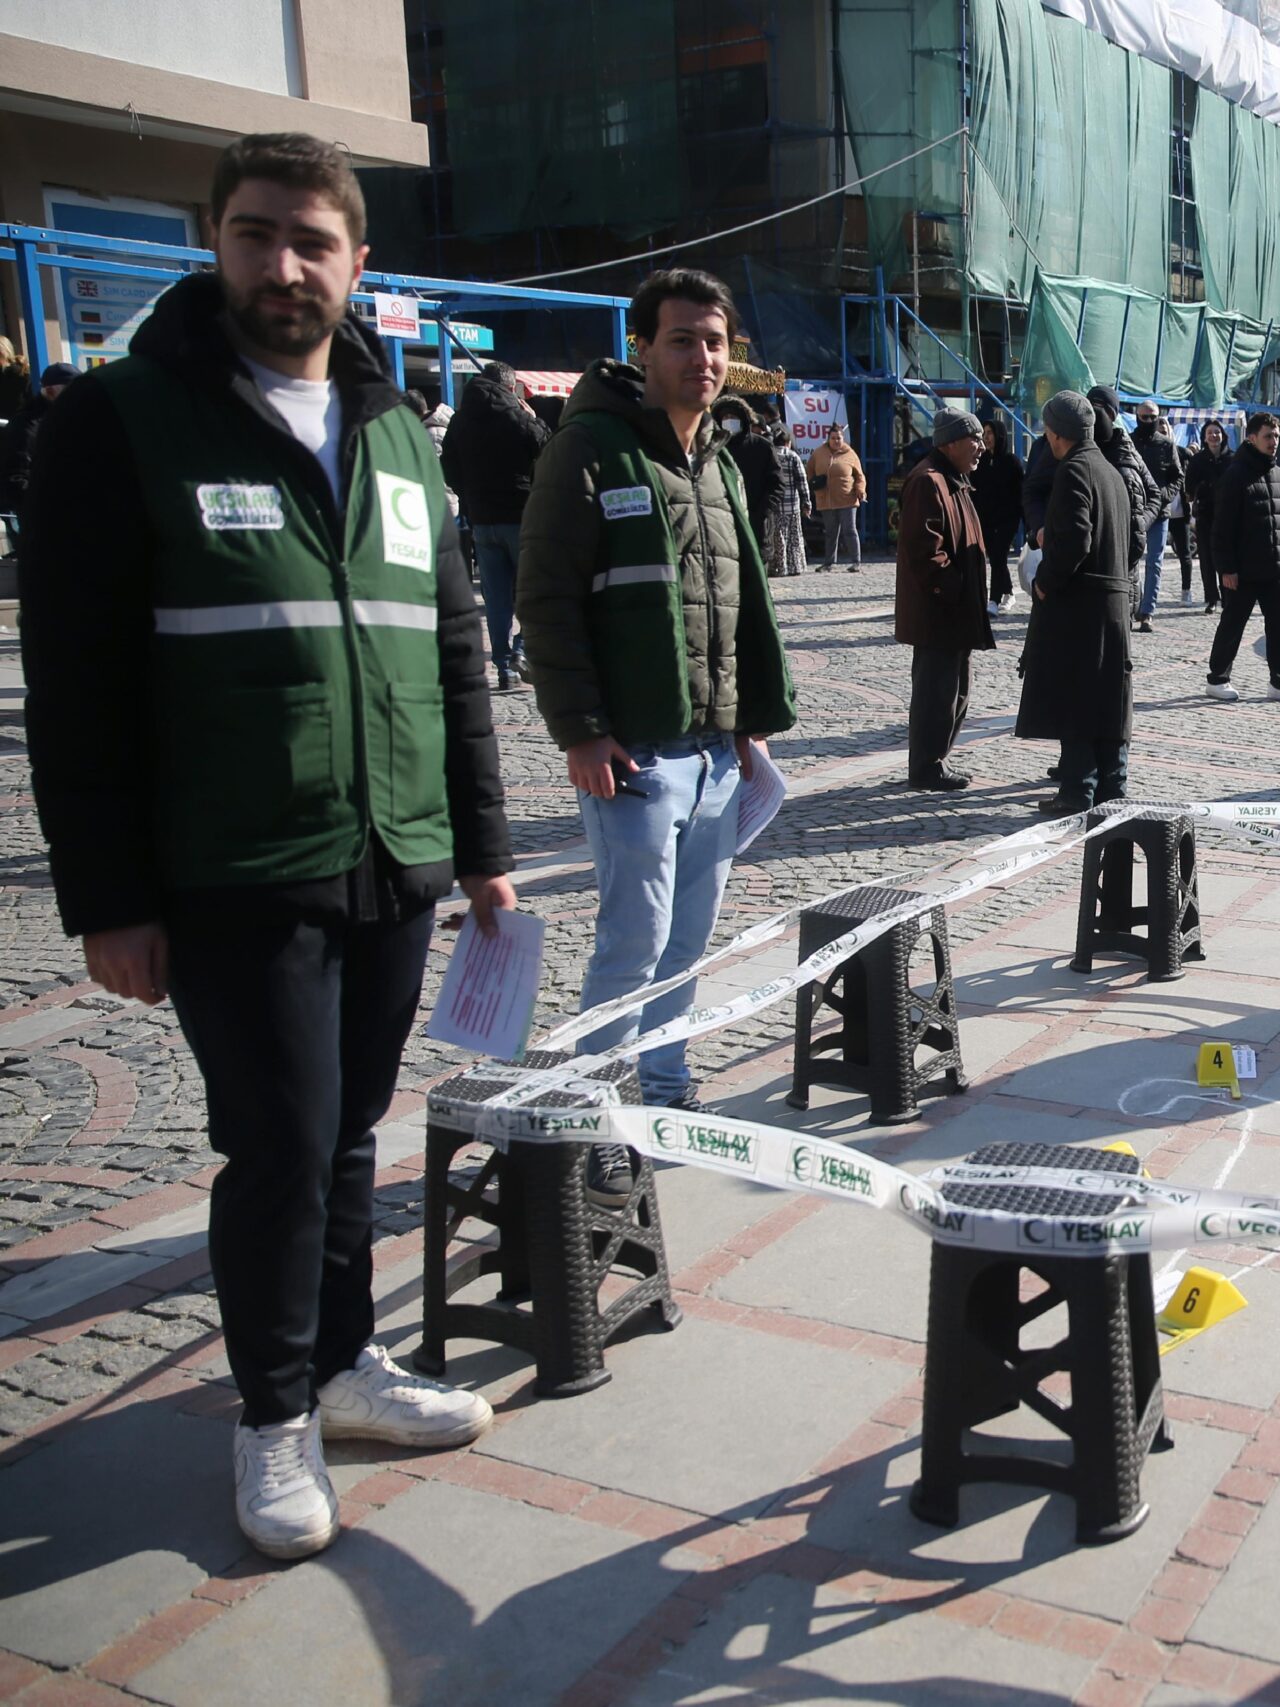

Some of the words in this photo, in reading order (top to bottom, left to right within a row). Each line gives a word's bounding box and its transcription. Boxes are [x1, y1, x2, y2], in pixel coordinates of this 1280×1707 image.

[459, 328, 479, 342] TAM
[804, 397, 830, 413] SU
[1213, 1050, 1223, 1069] 4
[1182, 1287, 1200, 1313] 6
